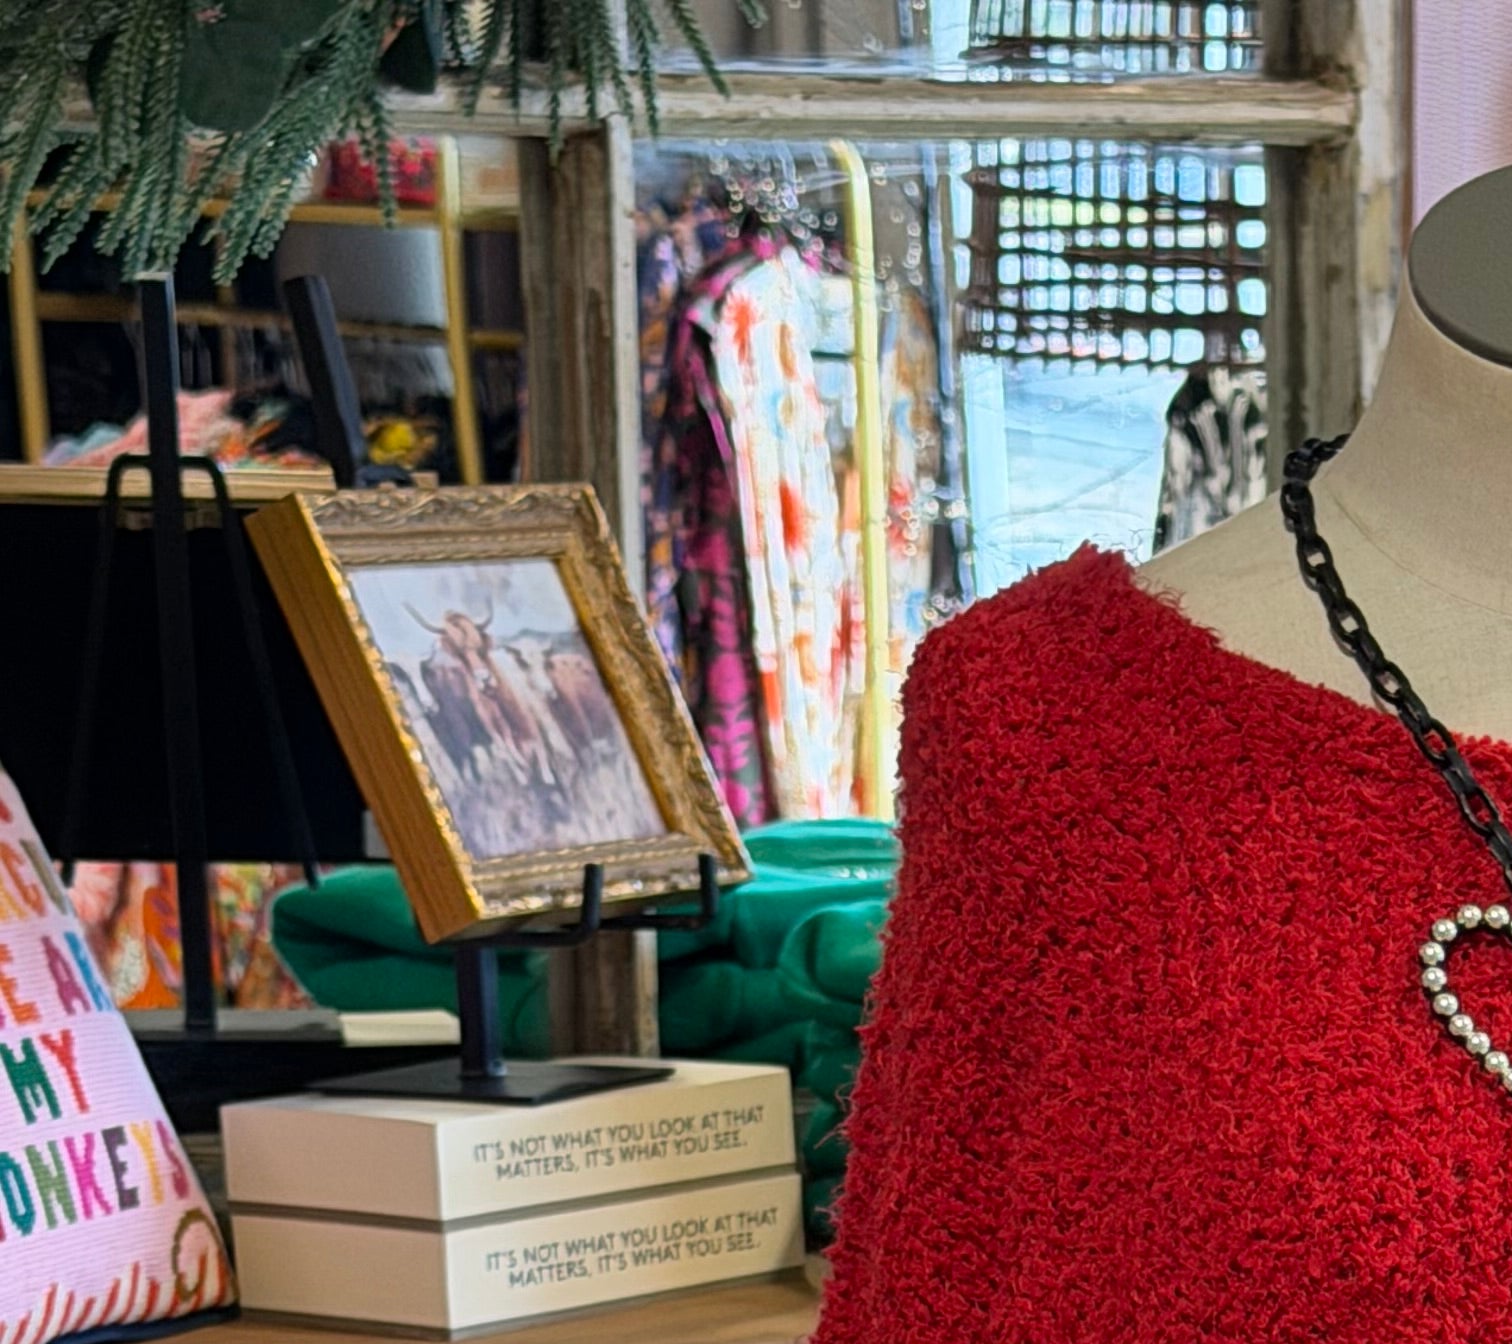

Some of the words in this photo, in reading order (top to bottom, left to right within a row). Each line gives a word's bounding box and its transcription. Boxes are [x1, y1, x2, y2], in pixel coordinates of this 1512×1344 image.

[0, 1029, 91, 1124] MY
[474, 1140, 504, 1163] IT'S
[510, 1135, 546, 1157] NOT
[551, 1127, 602, 1151] WHAT
[608, 1122, 644, 1143] YOU
[650, 1116, 695, 1140] LOOK
[702, 1111, 719, 1131] AT
[723, 1104, 764, 1127] THAT
[496, 1153, 580, 1180] MATTERS,
[586, 1148, 615, 1169] IT'S
[619, 1140, 667, 1163] WHAT
[674, 1135, 709, 1156] YOU
[714, 1129, 748, 1151] SEE.
[0, 1120, 190, 1242] ONKEYS
[486, 1249, 518, 1272] IT'S
[523, 1241, 559, 1264] NOT
[565, 1232, 615, 1257] WHAT
[620, 1225, 657, 1248] YOU
[663, 1216, 708, 1242] LOOK
[714, 1213, 732, 1233] AT
[736, 1206, 778, 1229] THAT
[509, 1258, 592, 1288] MATTERS,
[598, 1252, 628, 1273] IT'S
[632, 1241, 681, 1267] WHAT
[686, 1236, 722, 1257] YOU
[727, 1231, 761, 1253] SEE.
